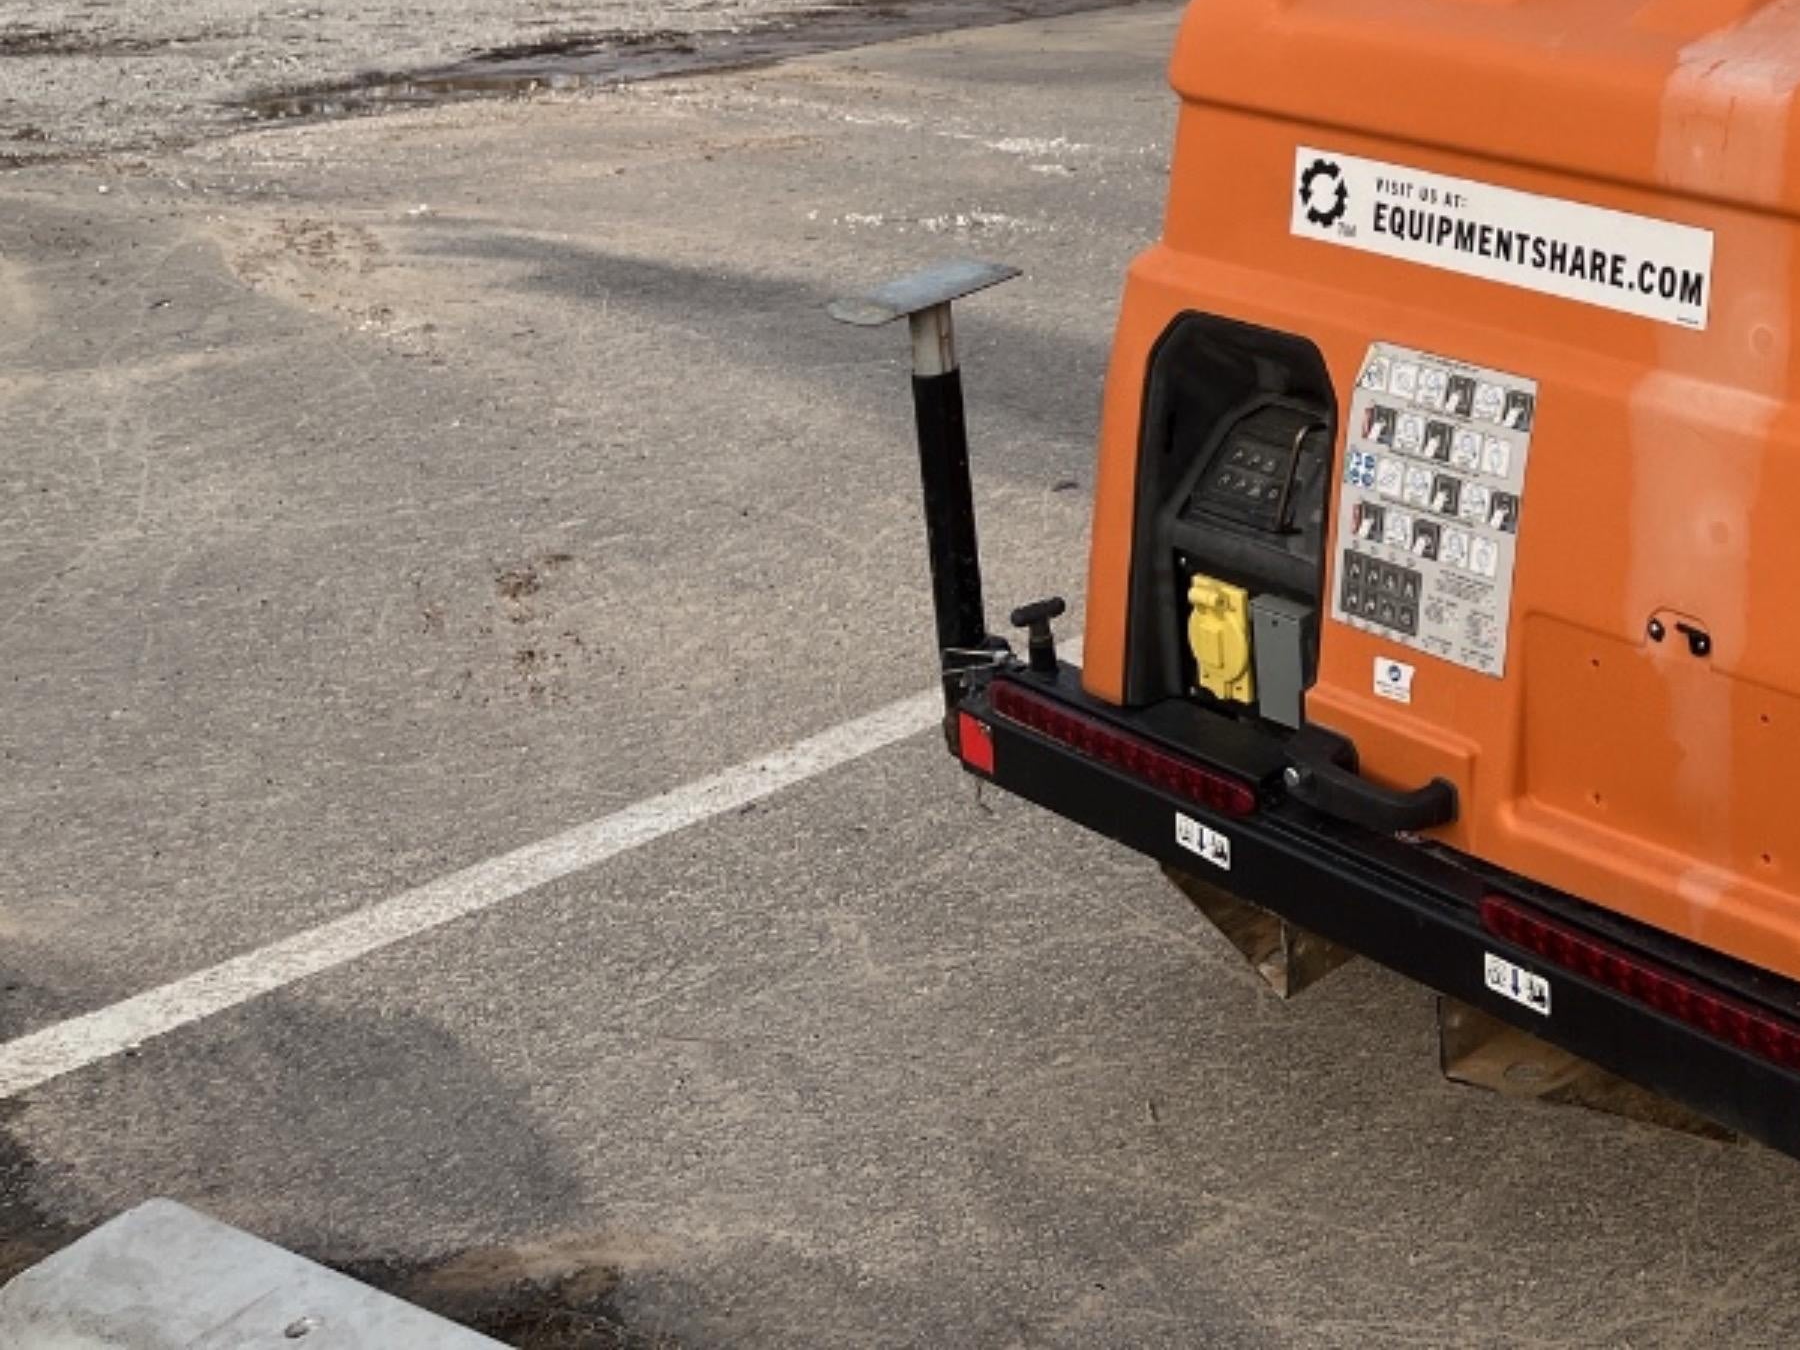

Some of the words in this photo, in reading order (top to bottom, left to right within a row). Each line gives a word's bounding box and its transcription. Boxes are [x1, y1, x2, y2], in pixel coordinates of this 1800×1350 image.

[1376, 177, 1414, 199] VISIT
[1418, 186, 1438, 205] US
[1444, 191, 1469, 209] AT:
[1373, 201, 1704, 307] EQUIPMENTSHARE.COM
